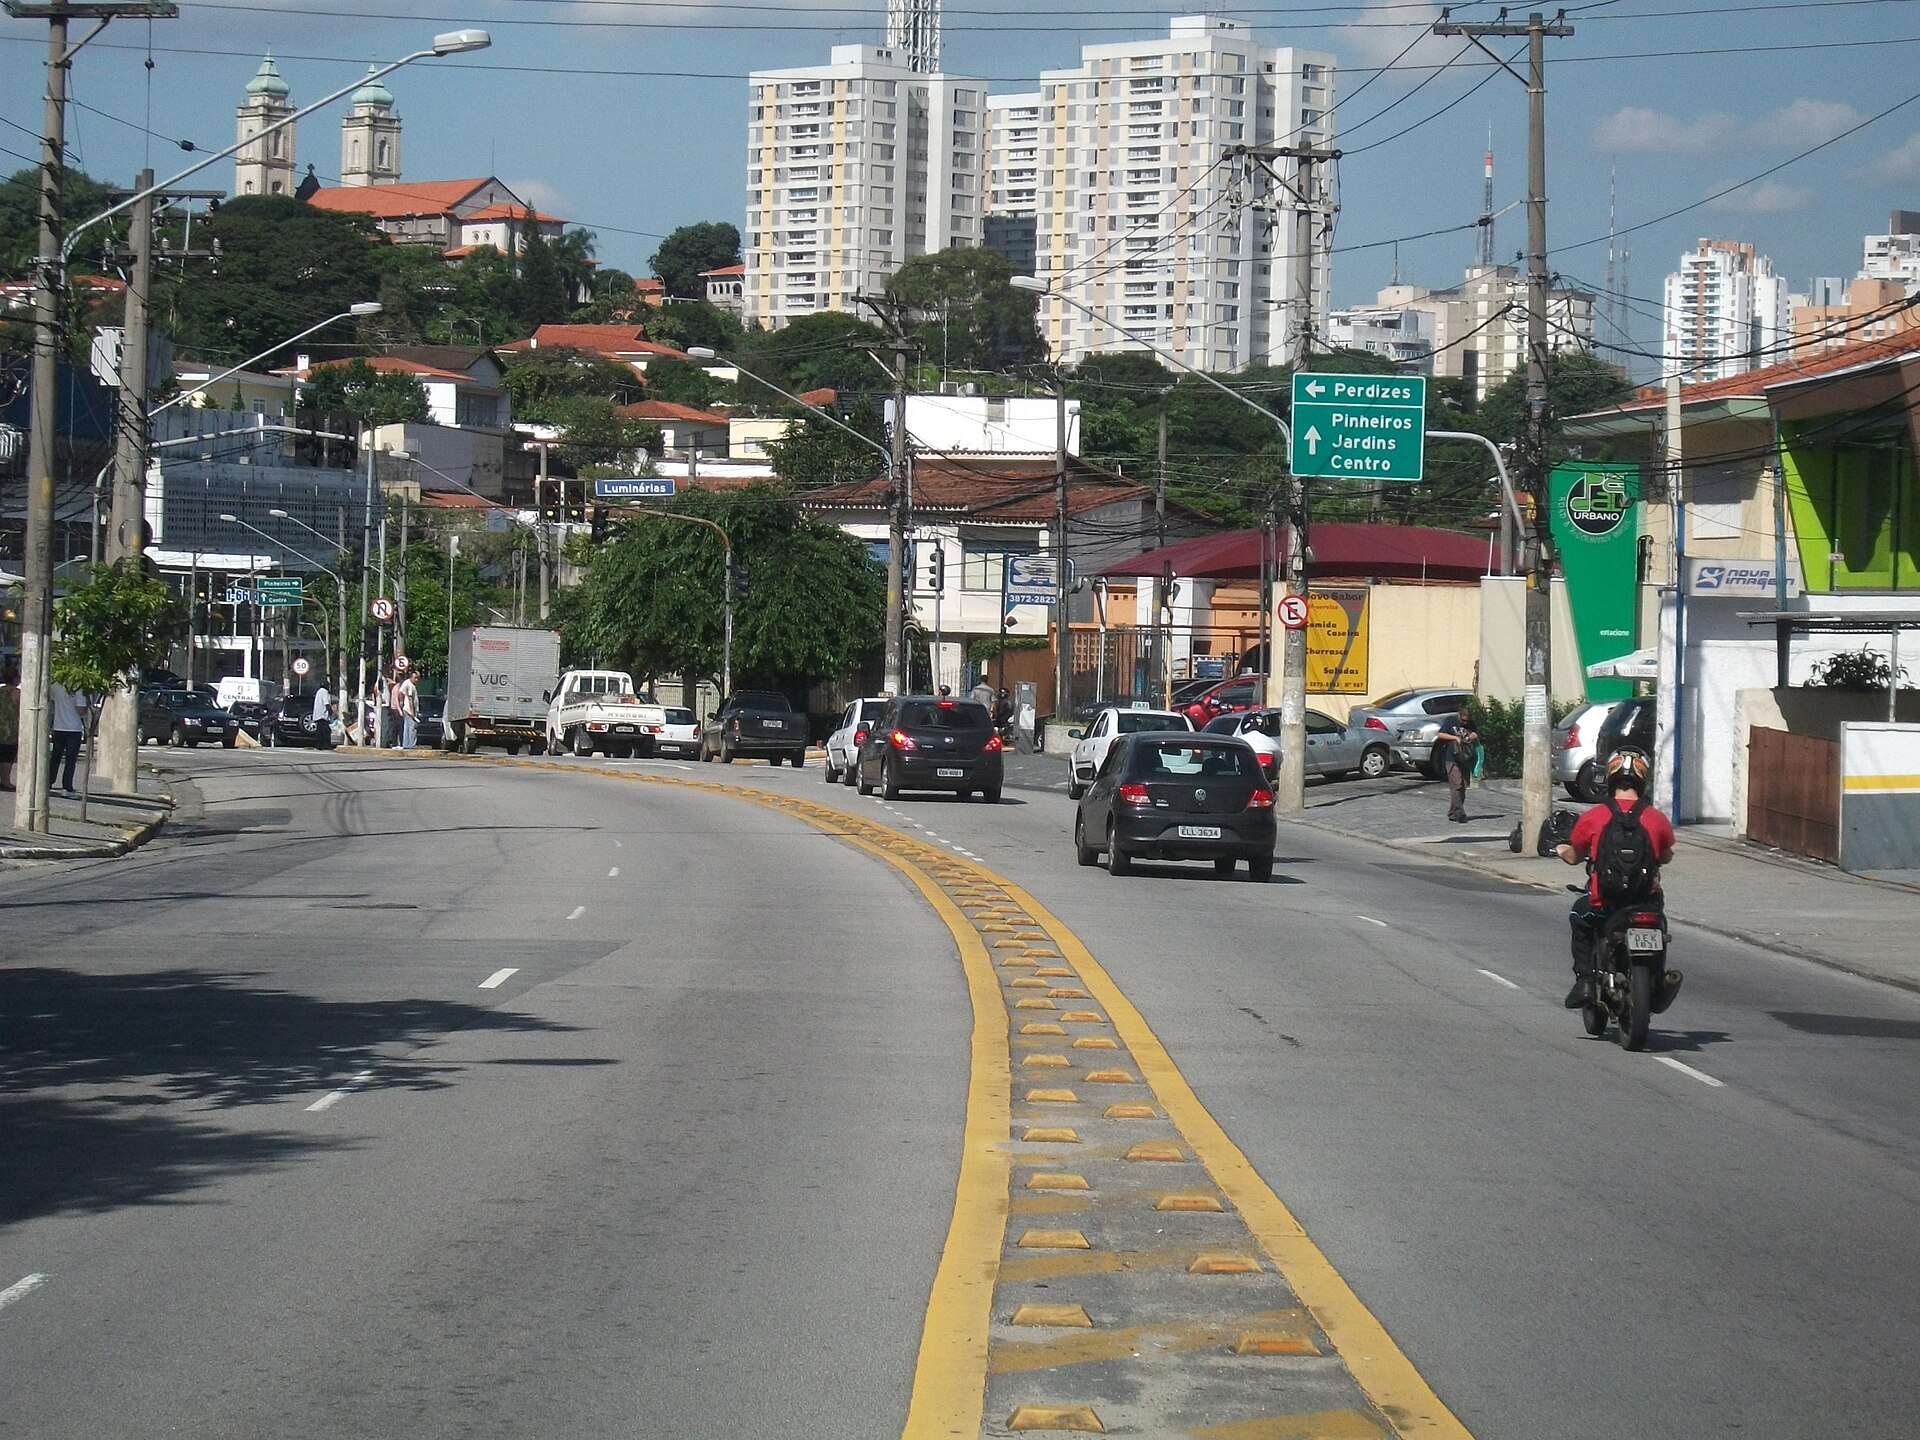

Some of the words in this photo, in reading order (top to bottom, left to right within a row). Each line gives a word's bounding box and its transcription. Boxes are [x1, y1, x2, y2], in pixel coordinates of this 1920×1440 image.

[1334, 382, 1411, 399] Perdizes
[1331, 413, 1412, 429] Pinheiros
[1332, 434, 1396, 450] Jardins
[1331, 455, 1391, 471] Centro
[604, 482, 666, 493] Luminárias
[1573, 512, 1619, 521] URBANO
[1009, 594, 1057, 604] 3872-2823
[1331, 592, 1364, 601] Sabor
[1326, 629, 1359, 637] Caseira
[1600, 628, 1630, 636] estacione
[1323, 666, 1359, 675] Saladas
[1181, 828, 1196, 837] ELL
[1198, 829, 1218, 838] 3634
